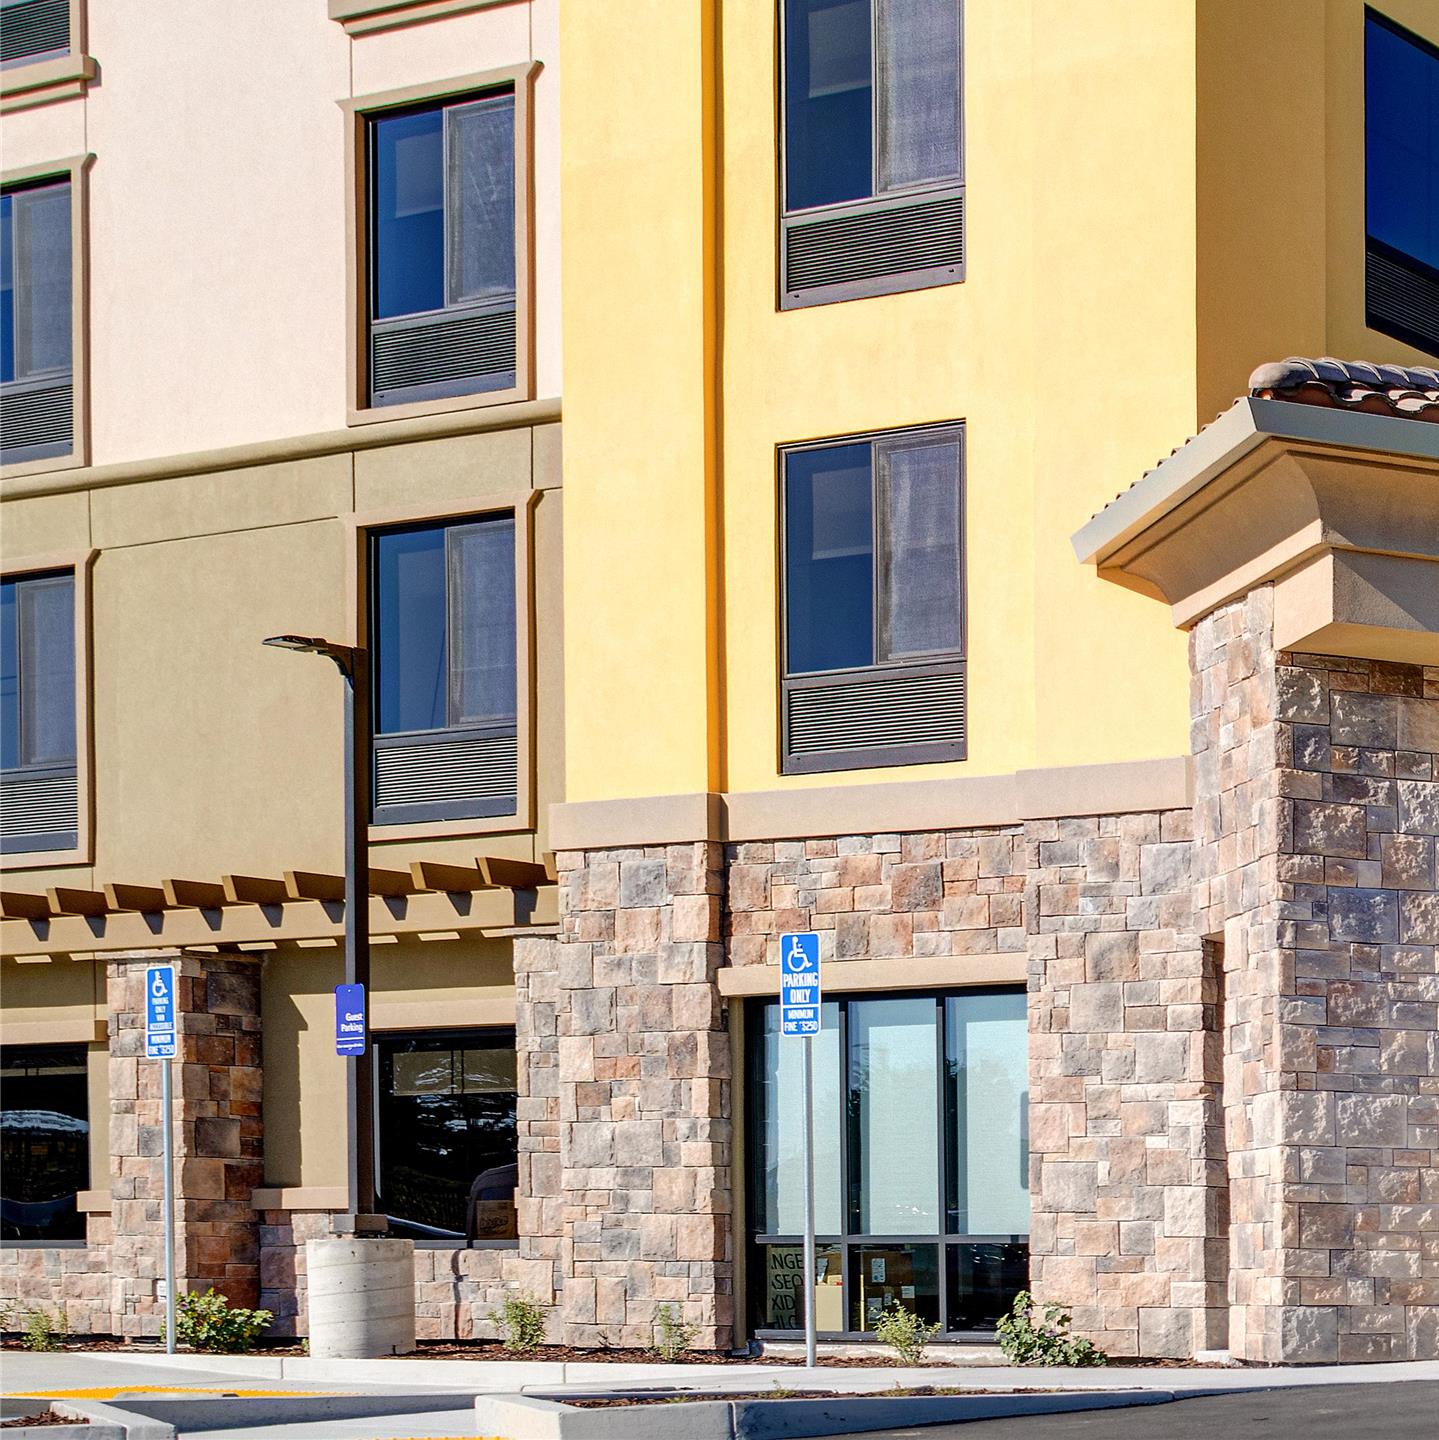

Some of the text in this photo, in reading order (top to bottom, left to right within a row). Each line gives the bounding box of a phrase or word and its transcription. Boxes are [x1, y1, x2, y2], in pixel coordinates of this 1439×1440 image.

[783, 972, 819, 988] PARKING
[789, 988, 811, 1004] ONLY
[345, 1012, 364, 1021] Guest
[787, 1009, 814, 1020] MINIMUM
[341, 1022, 363, 1033] Parking
[784, 1021, 798, 1033] FINE
